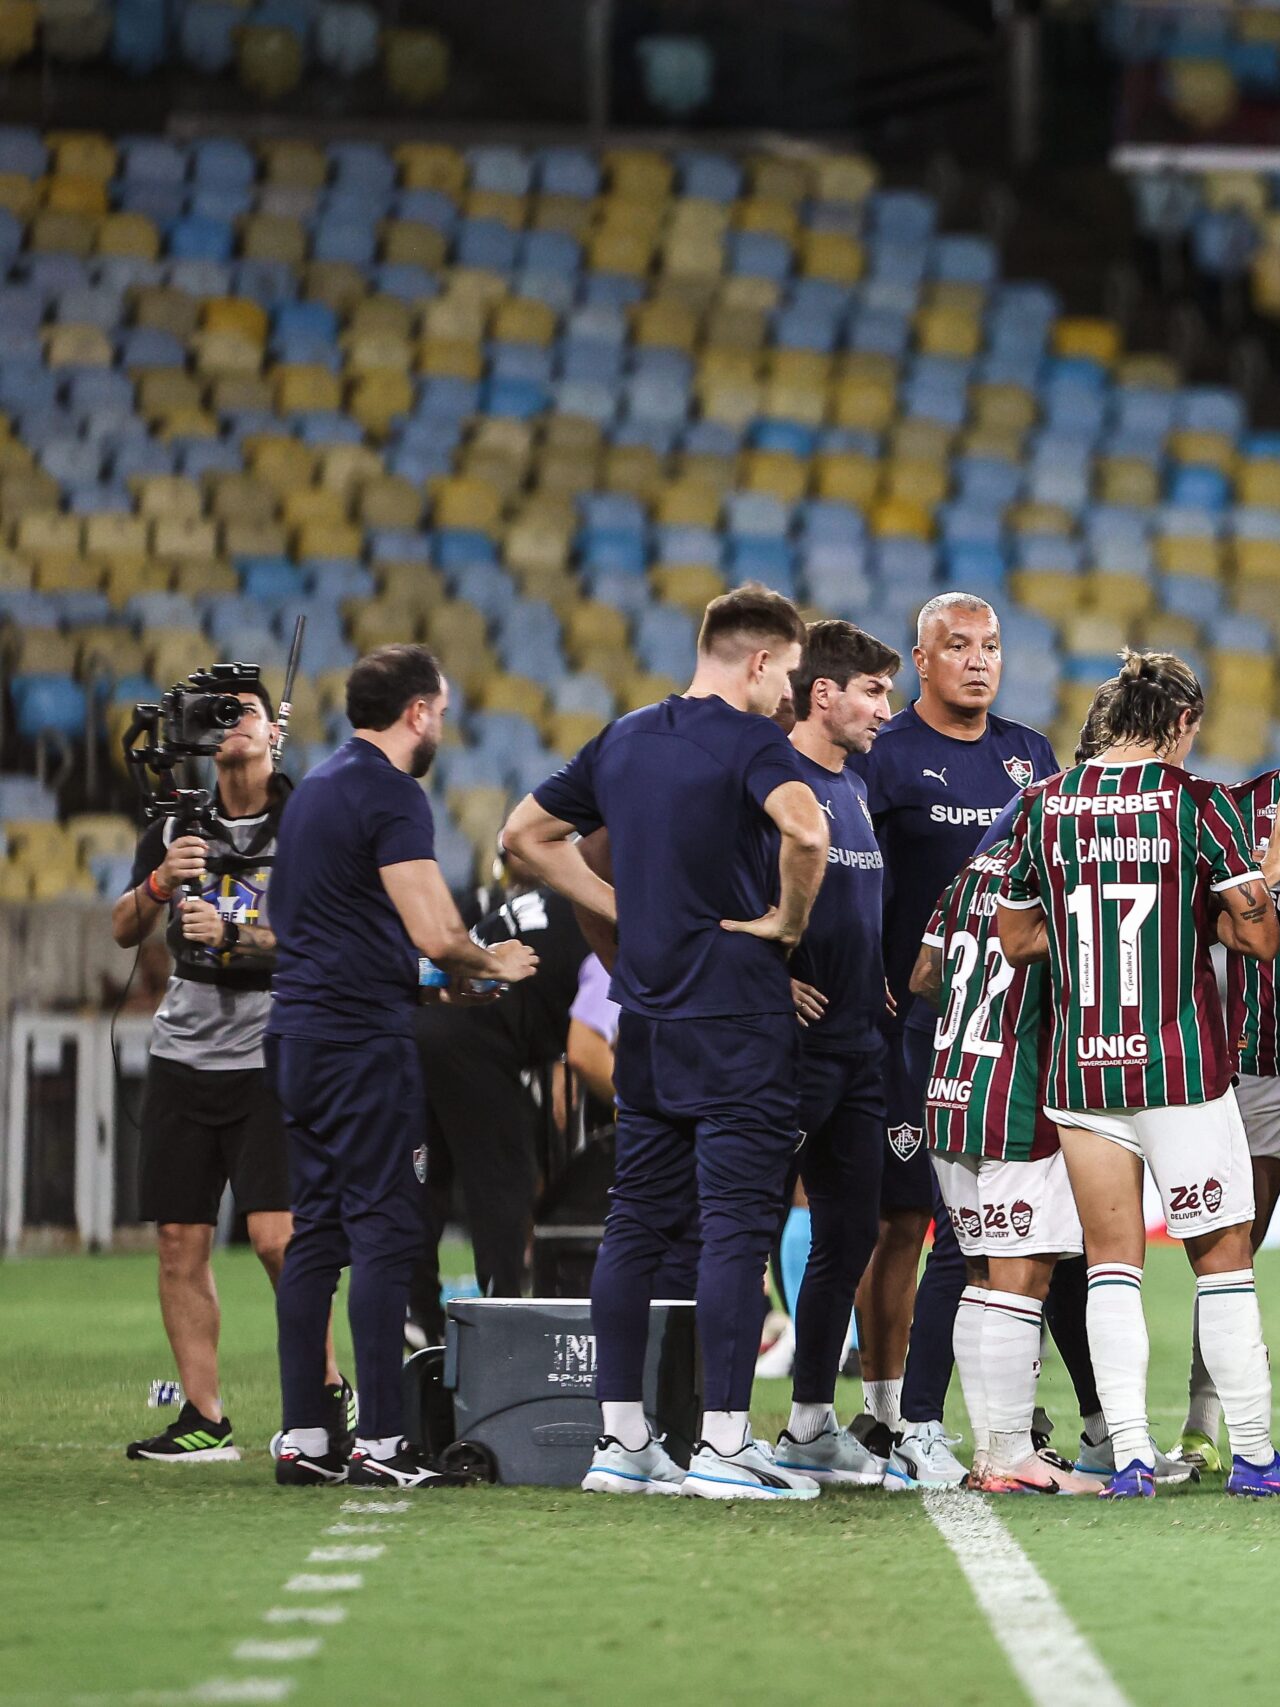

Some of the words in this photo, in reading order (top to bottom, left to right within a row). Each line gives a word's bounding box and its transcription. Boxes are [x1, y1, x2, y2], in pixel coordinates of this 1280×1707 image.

[1044, 790, 1174, 816] SUPERBET
[1052, 841, 1071, 867] A.
[1075, 836, 1171, 864] CANOBBIO
[1067, 884, 1157, 1007] 17
[933, 930, 1016, 1059] 32
[1077, 1034, 1148, 1059] UNIG
[1122, 1058, 1148, 1067] IGUAÇU
[926, 1077, 973, 1102] UNIG
[1169, 1183, 1202, 1212] Zé
[982, 1203, 1009, 1229] Zé
[1170, 1210, 1203, 1220] DELIVERY
[547, 1373, 597, 1383] SPOR
